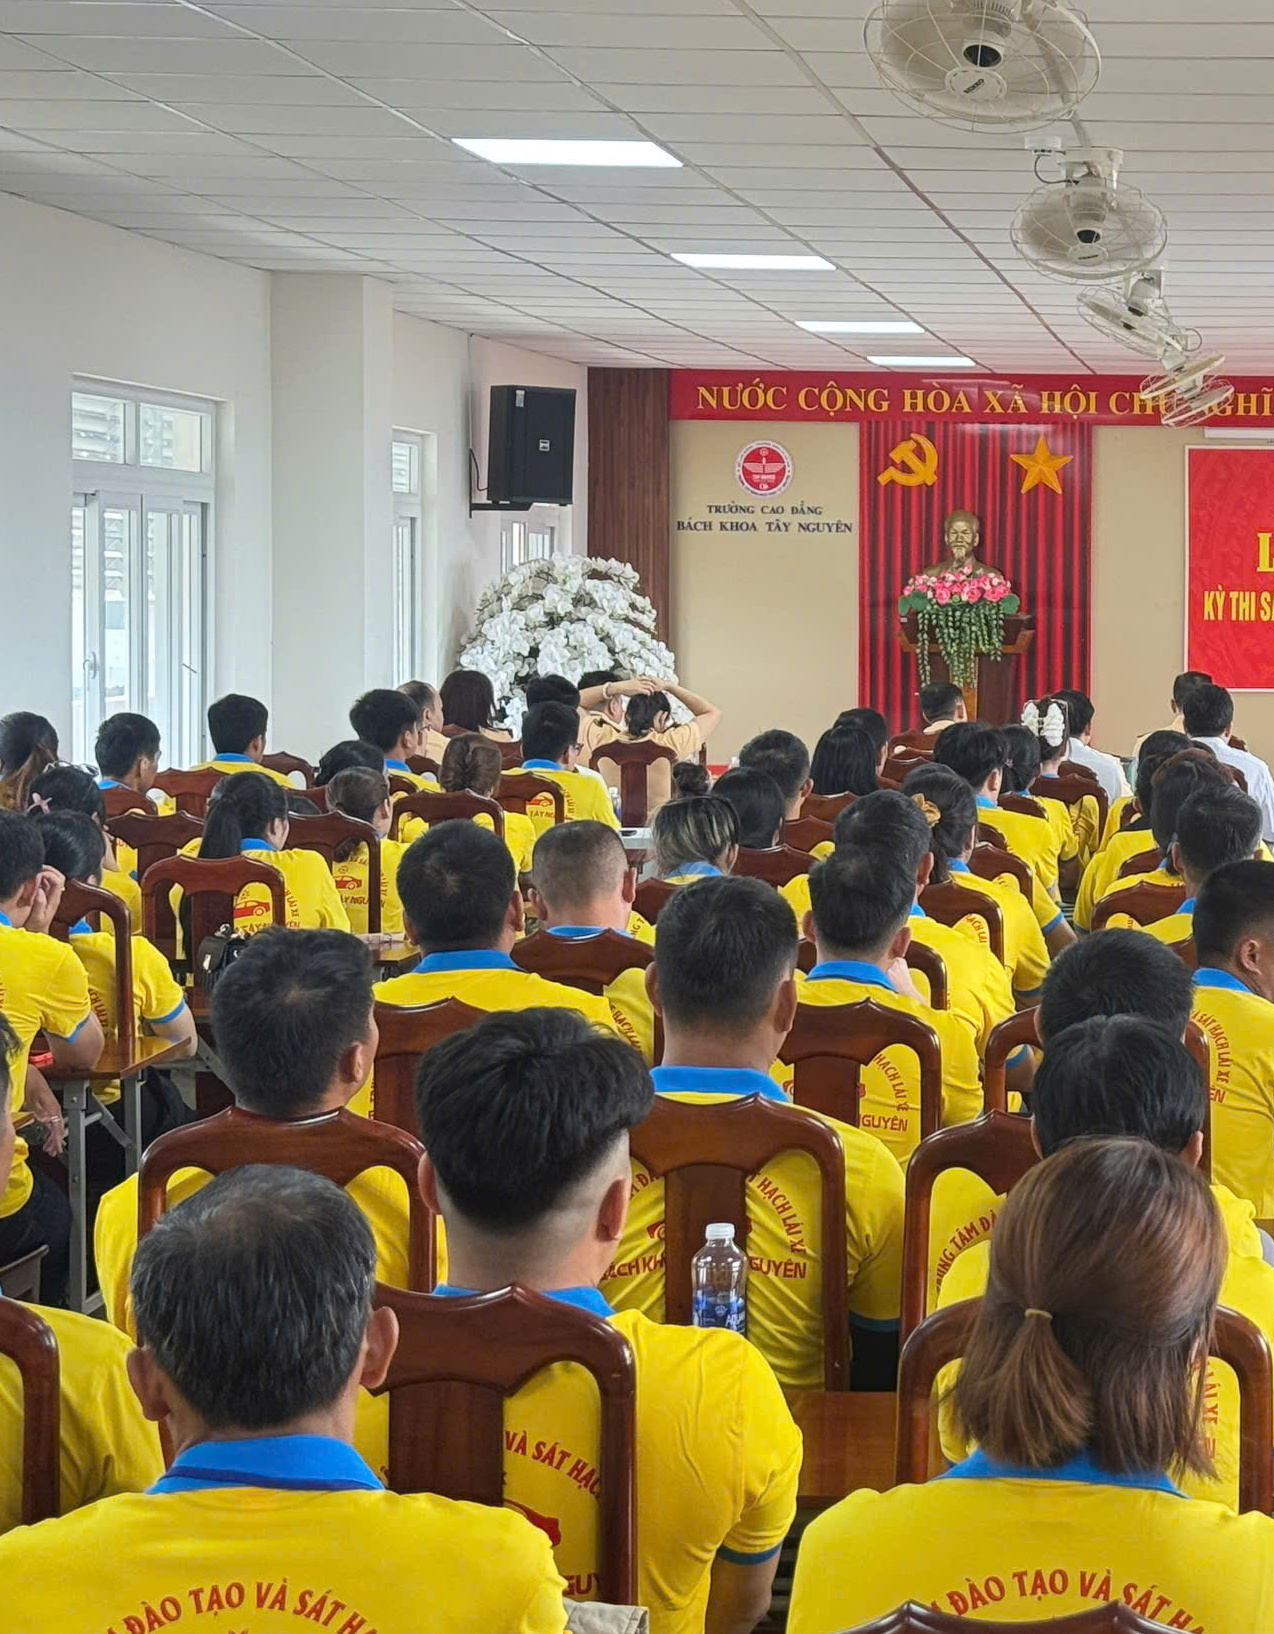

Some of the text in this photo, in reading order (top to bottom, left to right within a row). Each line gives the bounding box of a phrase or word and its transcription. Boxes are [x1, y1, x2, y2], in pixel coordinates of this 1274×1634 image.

[697, 378, 788, 410] NƯỚC
[798, 381, 890, 416] CỘNG
[902, 382, 970, 414] HÒA
[983, 385, 1028, 414] XÃ
[1041, 384, 1099, 420] HỘI
[707, 501, 755, 515] TRƯỜNG
[760, 506, 785, 515] CAO
[676, 517, 853, 533] BÁCH KHOA TÂY NGUYÊN
[1203, 585, 1226, 622] KỲ
[1229, 591, 1256, 622] THI
[859, 1113, 908, 1132] GUYÊN
[757, 1176, 793, 1216] HẠCH
[782, 1213, 804, 1236] LÁI
[949, 1221, 980, 1251] TÂM
[642, 1254, 664, 1273] KH
[747, 1256, 807, 1279] GUYÊN
[504, 1430, 602, 1499] VÀ SÁT HẠC
[122, 1595, 183, 1634] ĐÀO
[188, 1582, 246, 1617] TẠO
[255, 1577, 288, 1612] VÀ
[292, 1589, 347, 1627] SÁT
[946, 1568, 1173, 1620] ĐÀO TẠO VÀ SÁT
